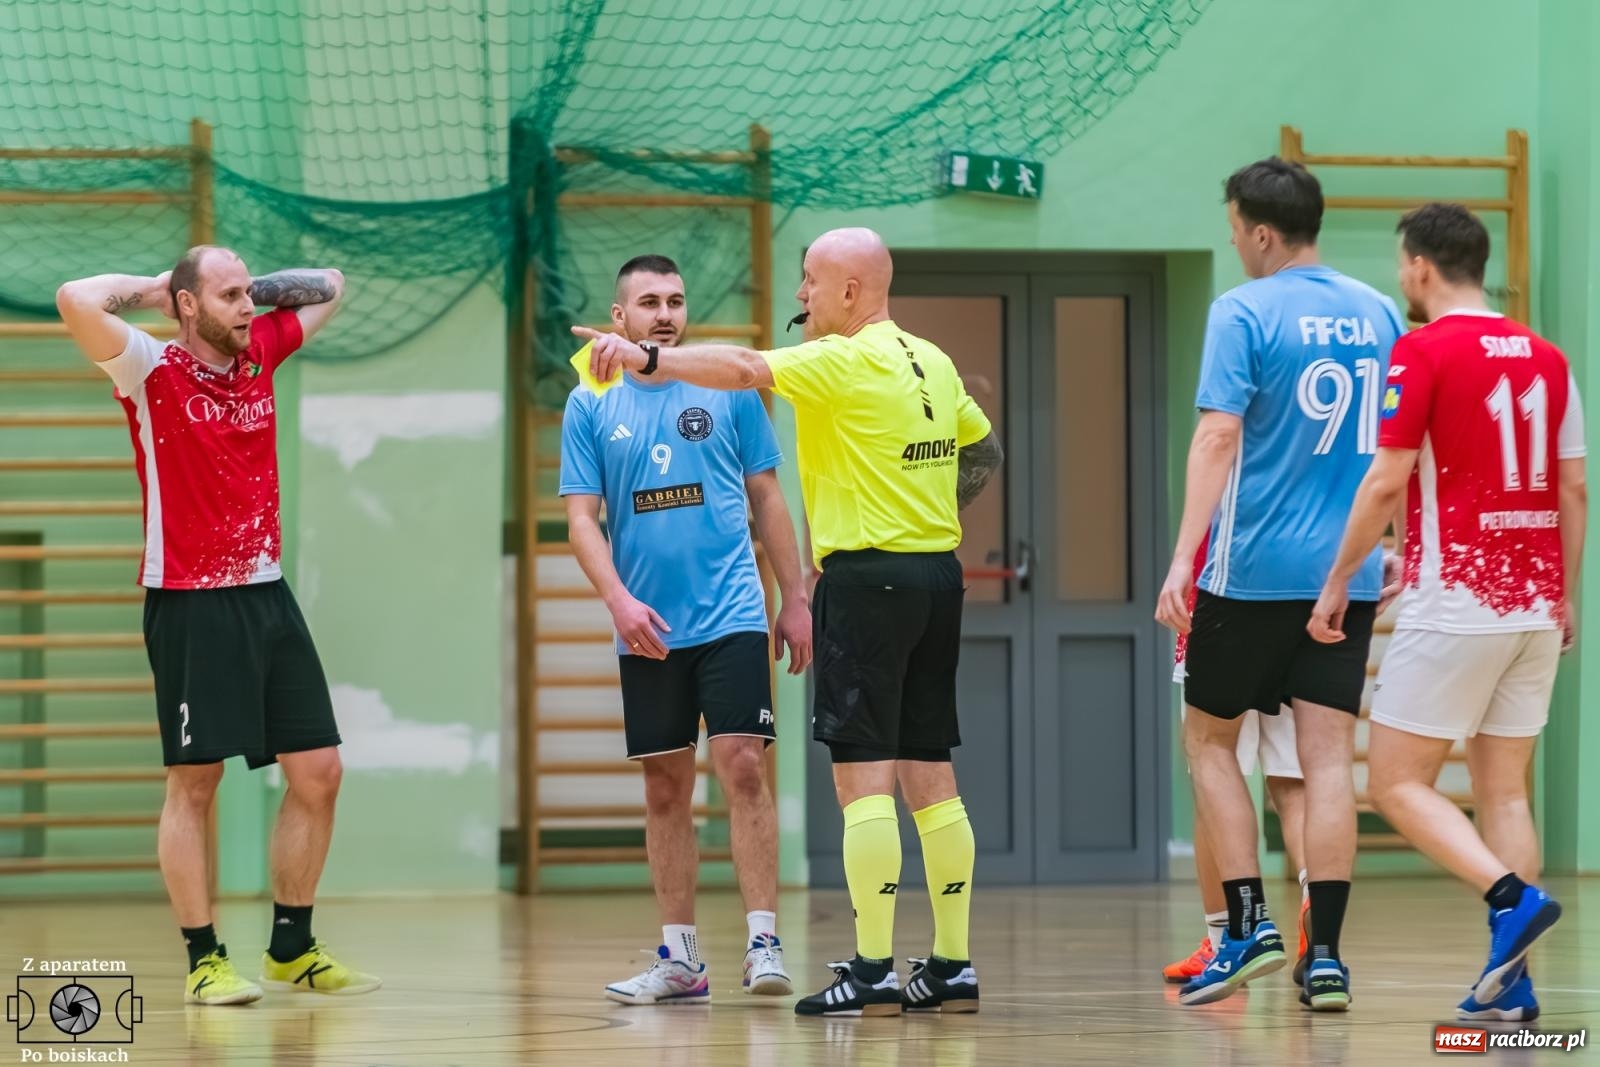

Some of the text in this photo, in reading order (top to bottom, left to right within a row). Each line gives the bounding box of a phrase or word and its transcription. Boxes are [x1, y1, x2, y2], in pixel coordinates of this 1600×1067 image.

[1480, 335, 1533, 358] START
[1297, 357, 1380, 455] 91
[1484, 372, 1549, 492] 11
[651, 443, 672, 475] 9
[901, 438, 956, 461] 4MOVE
[635, 486, 703, 504] GABRIEL
[179, 702, 192, 747] 2
